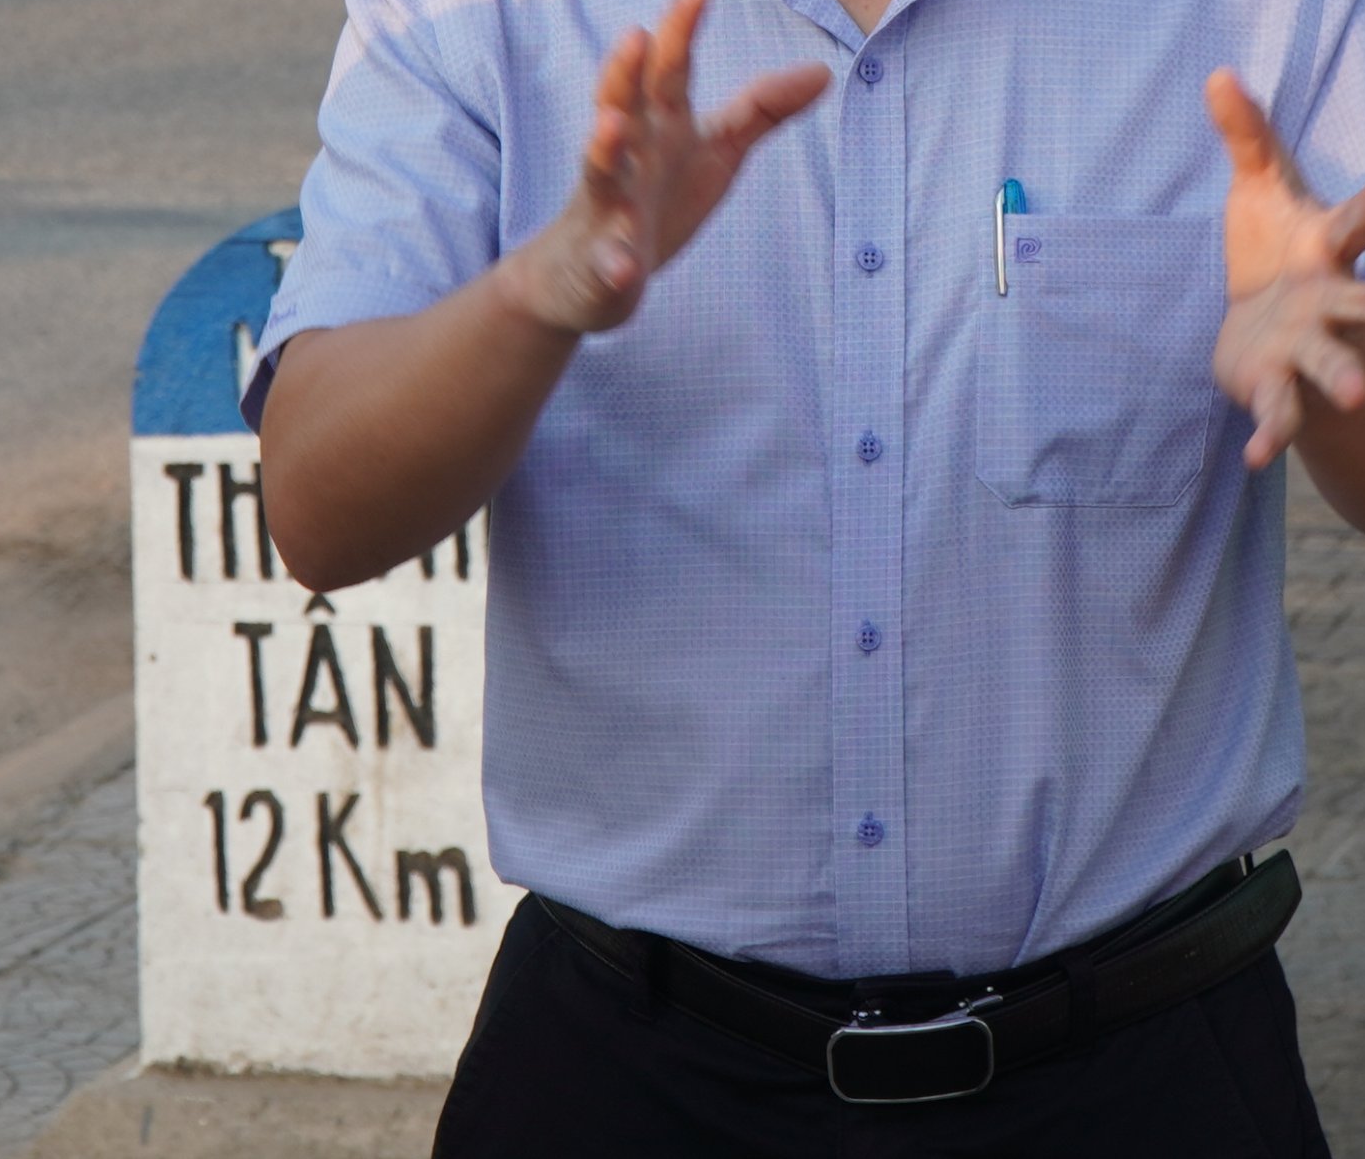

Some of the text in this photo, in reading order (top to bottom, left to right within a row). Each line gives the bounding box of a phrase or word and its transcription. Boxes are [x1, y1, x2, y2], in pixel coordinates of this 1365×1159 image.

[233, 592, 438, 749] TÂN
[203, 787, 479, 927] 12 Km
